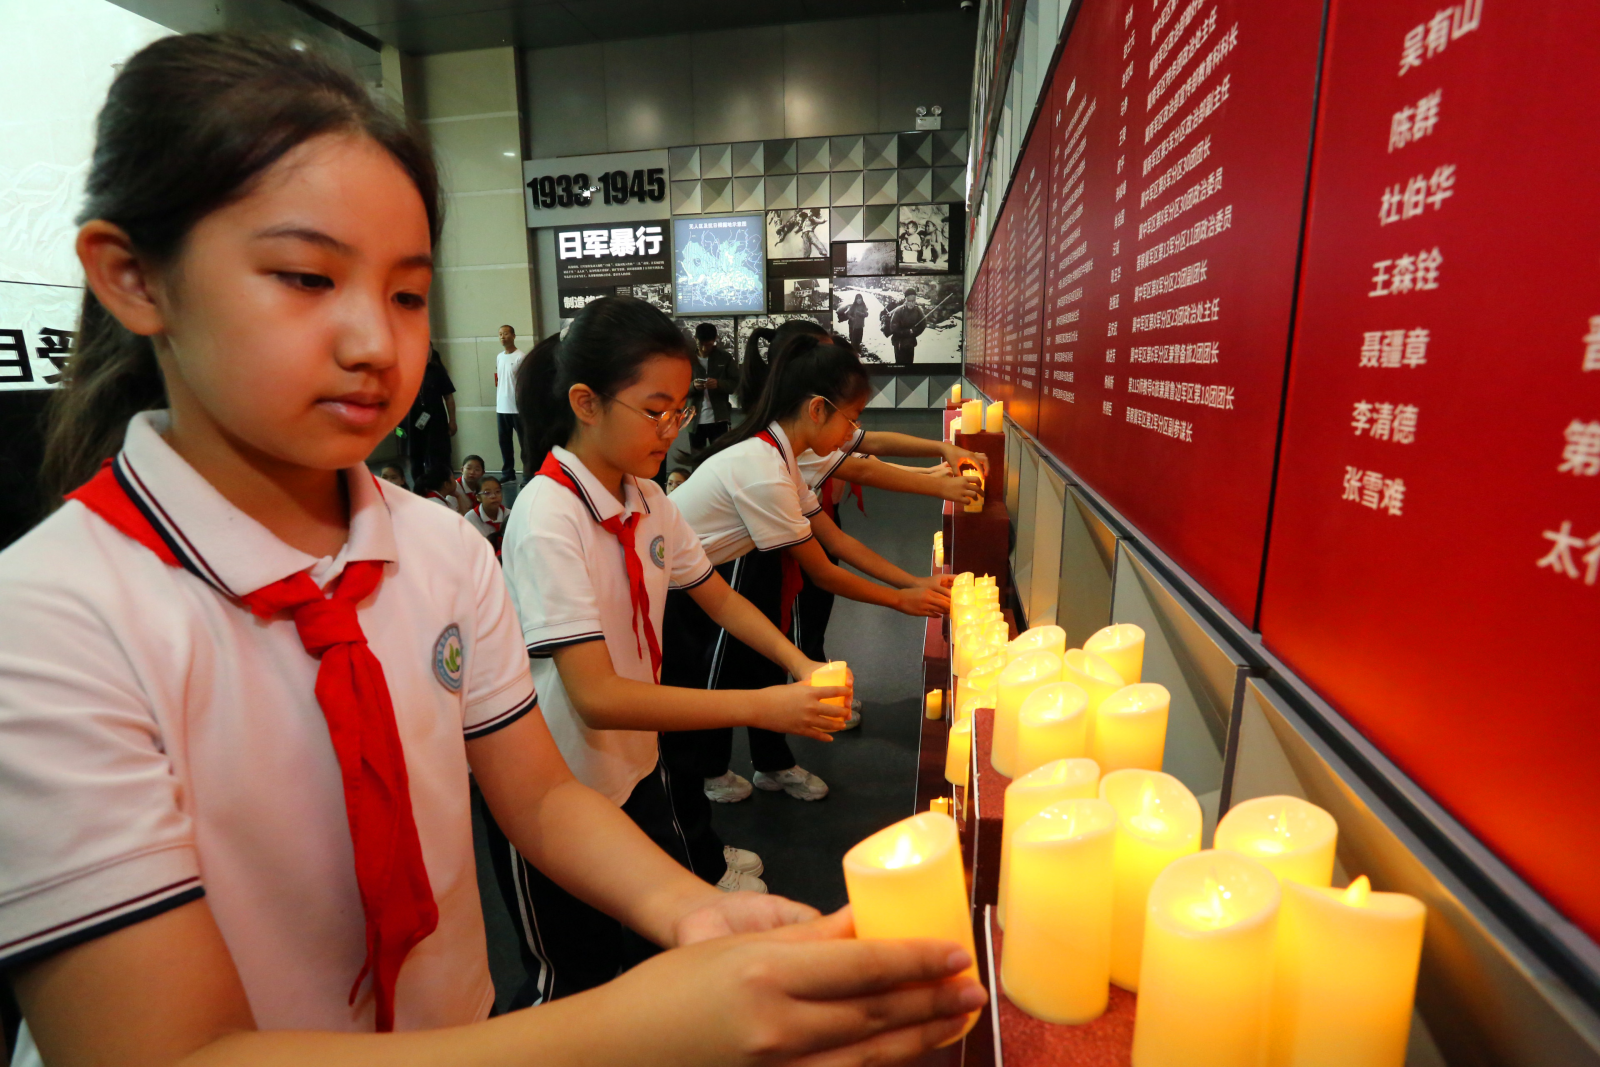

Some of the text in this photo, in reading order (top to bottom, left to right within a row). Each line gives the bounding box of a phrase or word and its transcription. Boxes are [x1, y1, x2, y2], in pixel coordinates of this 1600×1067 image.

[1398, 0, 1484, 77] 吴有山
[1388, 88, 1442, 154] 陈群
[1378, 164, 1456, 227] 杜伯华
[558, 225, 663, 260] 日军暴行
[1368, 247, 1443, 297] 王森铨
[563, 294, 608, 309] 制造
[1351, 400, 1419, 445] 李清德
